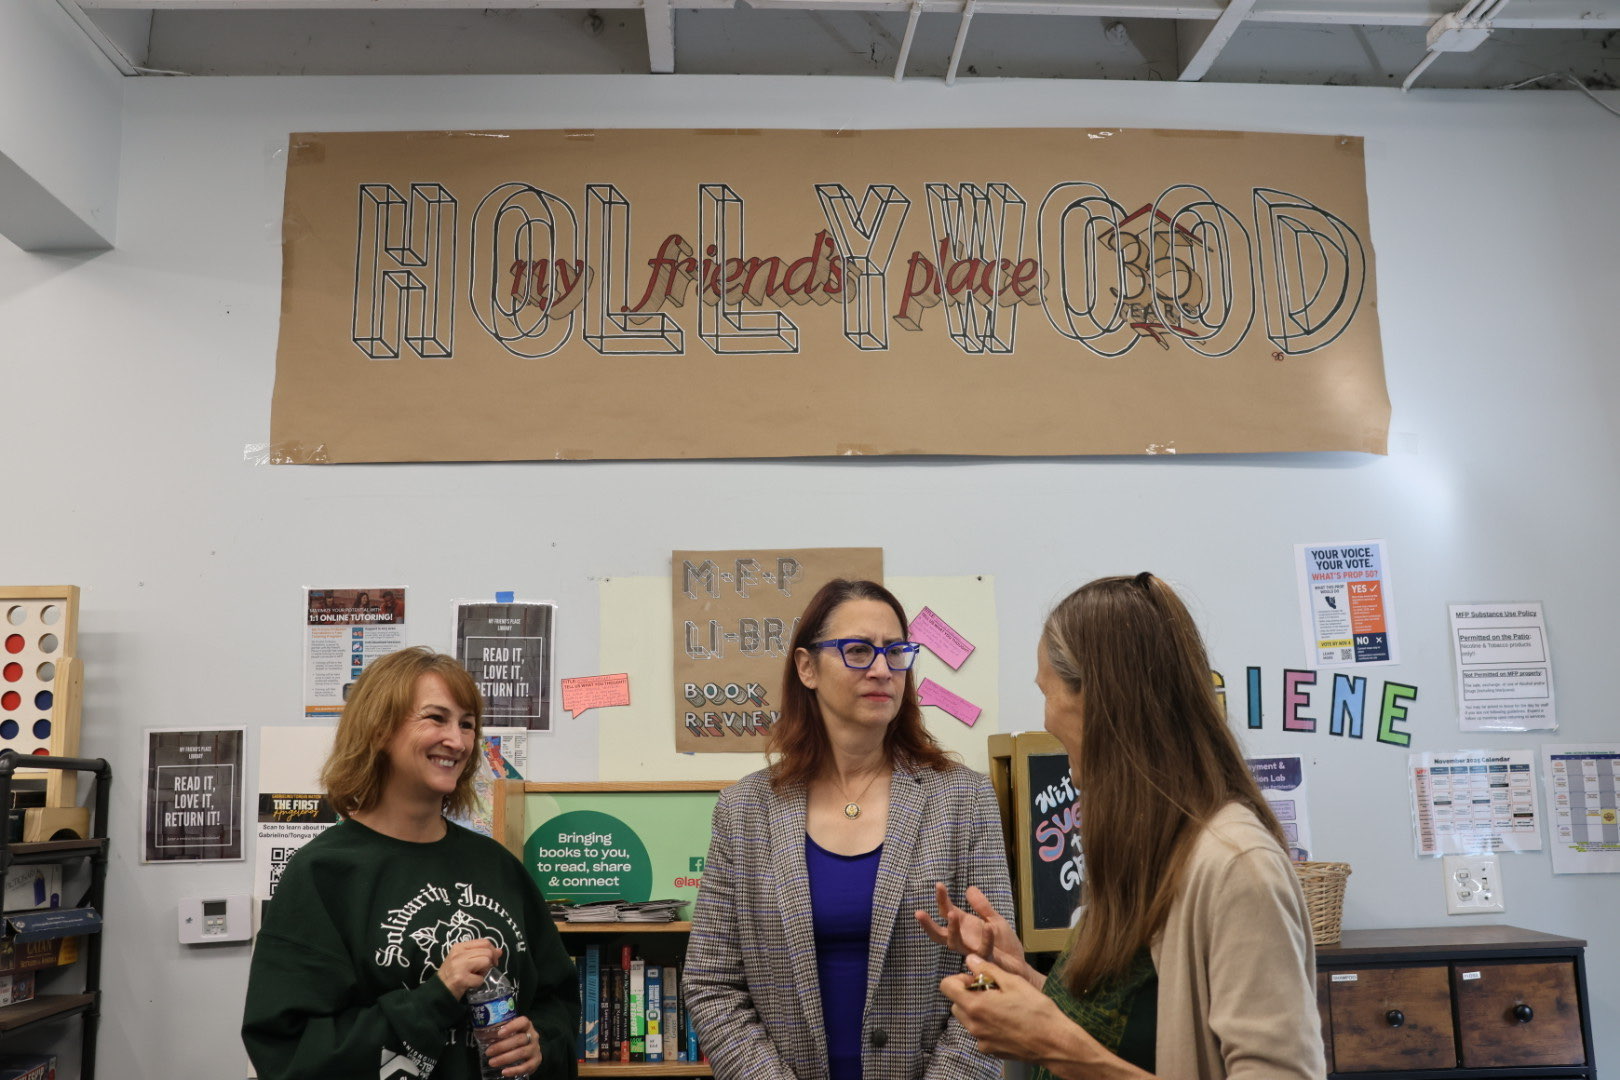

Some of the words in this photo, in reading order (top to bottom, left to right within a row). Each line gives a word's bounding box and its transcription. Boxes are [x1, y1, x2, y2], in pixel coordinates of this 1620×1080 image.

[352, 183, 1365, 360] HOLLYWOOD
[510, 257, 590, 317] my
[896, 238, 1046, 328] place
[1311, 550, 1338, 560] YOUR
[1341, 548, 1374, 559] VOICE.
[1316, 560, 1343, 570] YOUR
[1346, 558, 1373, 569] VOTE.
[1312, 572, 1342, 580] WHAT'S
[1343, 571, 1364, 579] PROP
[1351, 585, 1367, 594] YES
[1356, 637, 1369, 645] NO
[483, 648, 508, 662] READ
[512, 648, 524, 665] IT,
[484, 665, 508, 680] LOVE
[511, 665, 523, 682] IT,
[475, 683, 513, 698] RETURN
[516, 683, 529, 697] IT!
[683, 682, 770, 708] BOOK
[174, 776, 200, 791] READ
[204, 776, 216, 792] IT,
[175, 794, 199, 809] LOVE
[202, 794, 214, 810] IT,
[274, 800, 292, 810] THE
[293, 800, 319, 810] FIRST
[165, 812, 204, 827] RETURN
[207, 811, 220, 825] IT!
[558, 832, 612, 846] Bringing
[539, 847, 581, 858] books
[584, 848, 598, 858] to
[601, 849, 630, 862] you,
[537, 862, 552, 872] to
[555, 862, 590, 874] read,
[592, 862, 631, 872] share
[548, 876, 560, 887] &
[562, 876, 620, 887] connect
[375, 883, 452, 968] Solidarity
[455, 883, 527, 954] Journey
